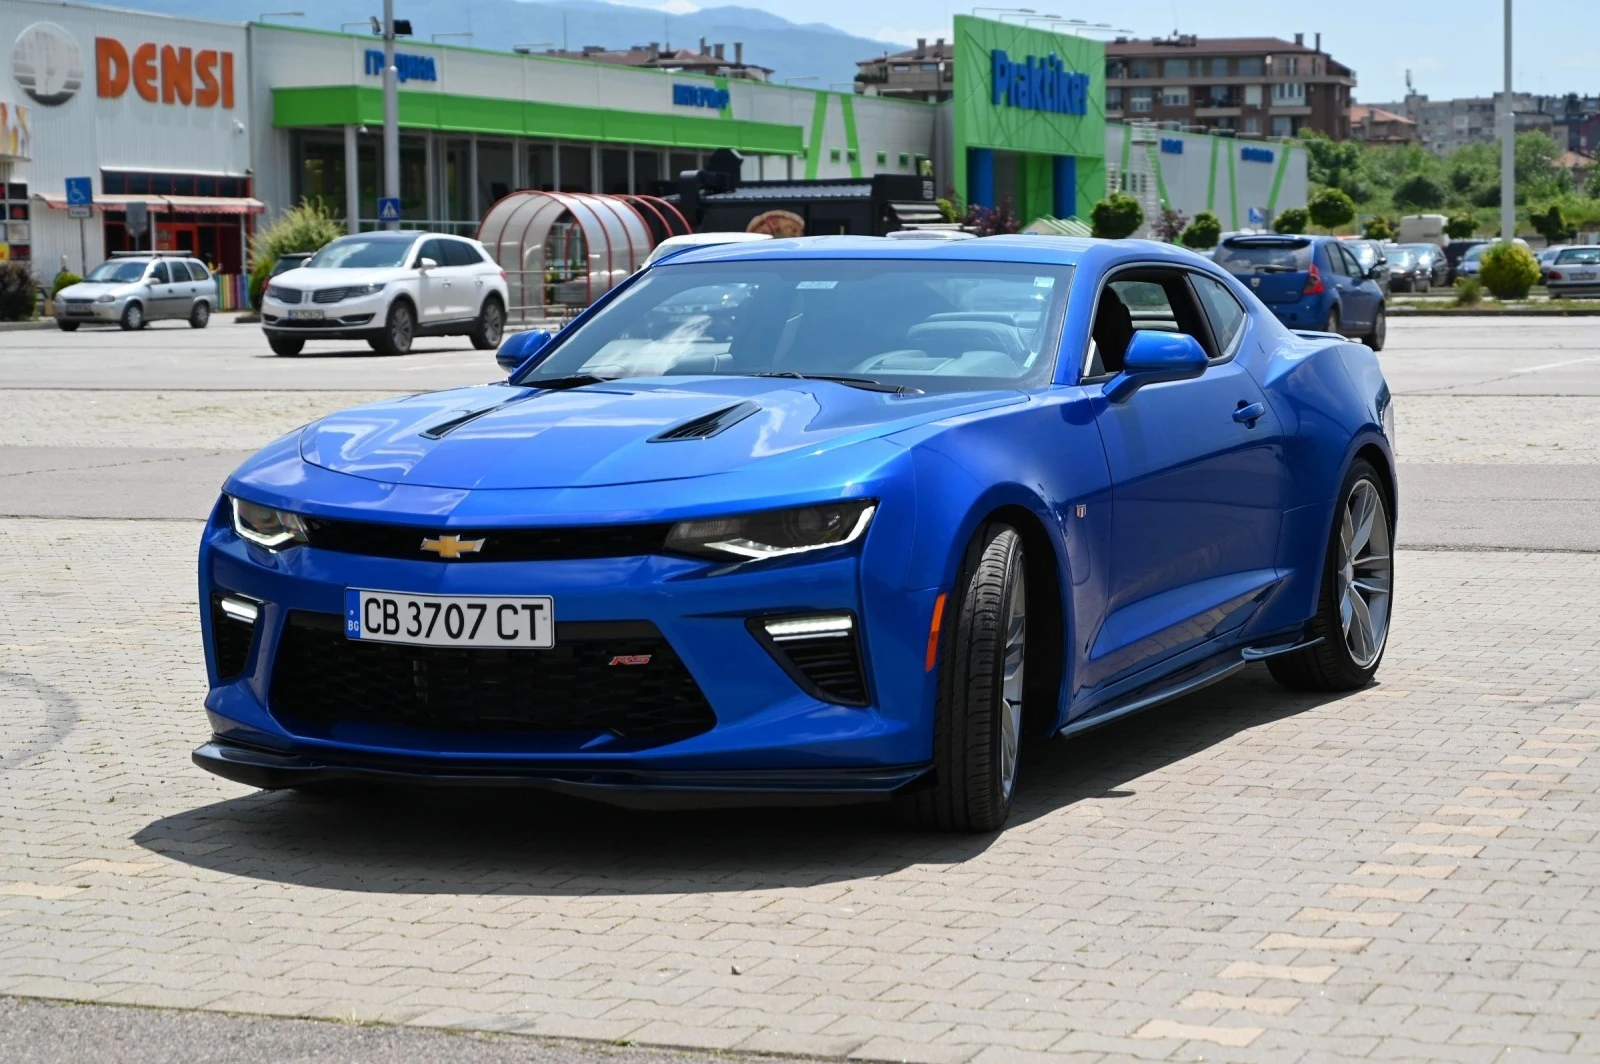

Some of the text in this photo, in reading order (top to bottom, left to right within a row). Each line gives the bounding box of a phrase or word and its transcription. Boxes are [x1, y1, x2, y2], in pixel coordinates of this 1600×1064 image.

[95, 37, 235, 109] DENSI
[364, 49, 436, 83] ГРДИНА
[991, 49, 1089, 116] Praktiker
[348, 620, 360, 631] BG
[364, 597, 544, 641] CB 3707 CT
[608, 654, 652, 666] RS
